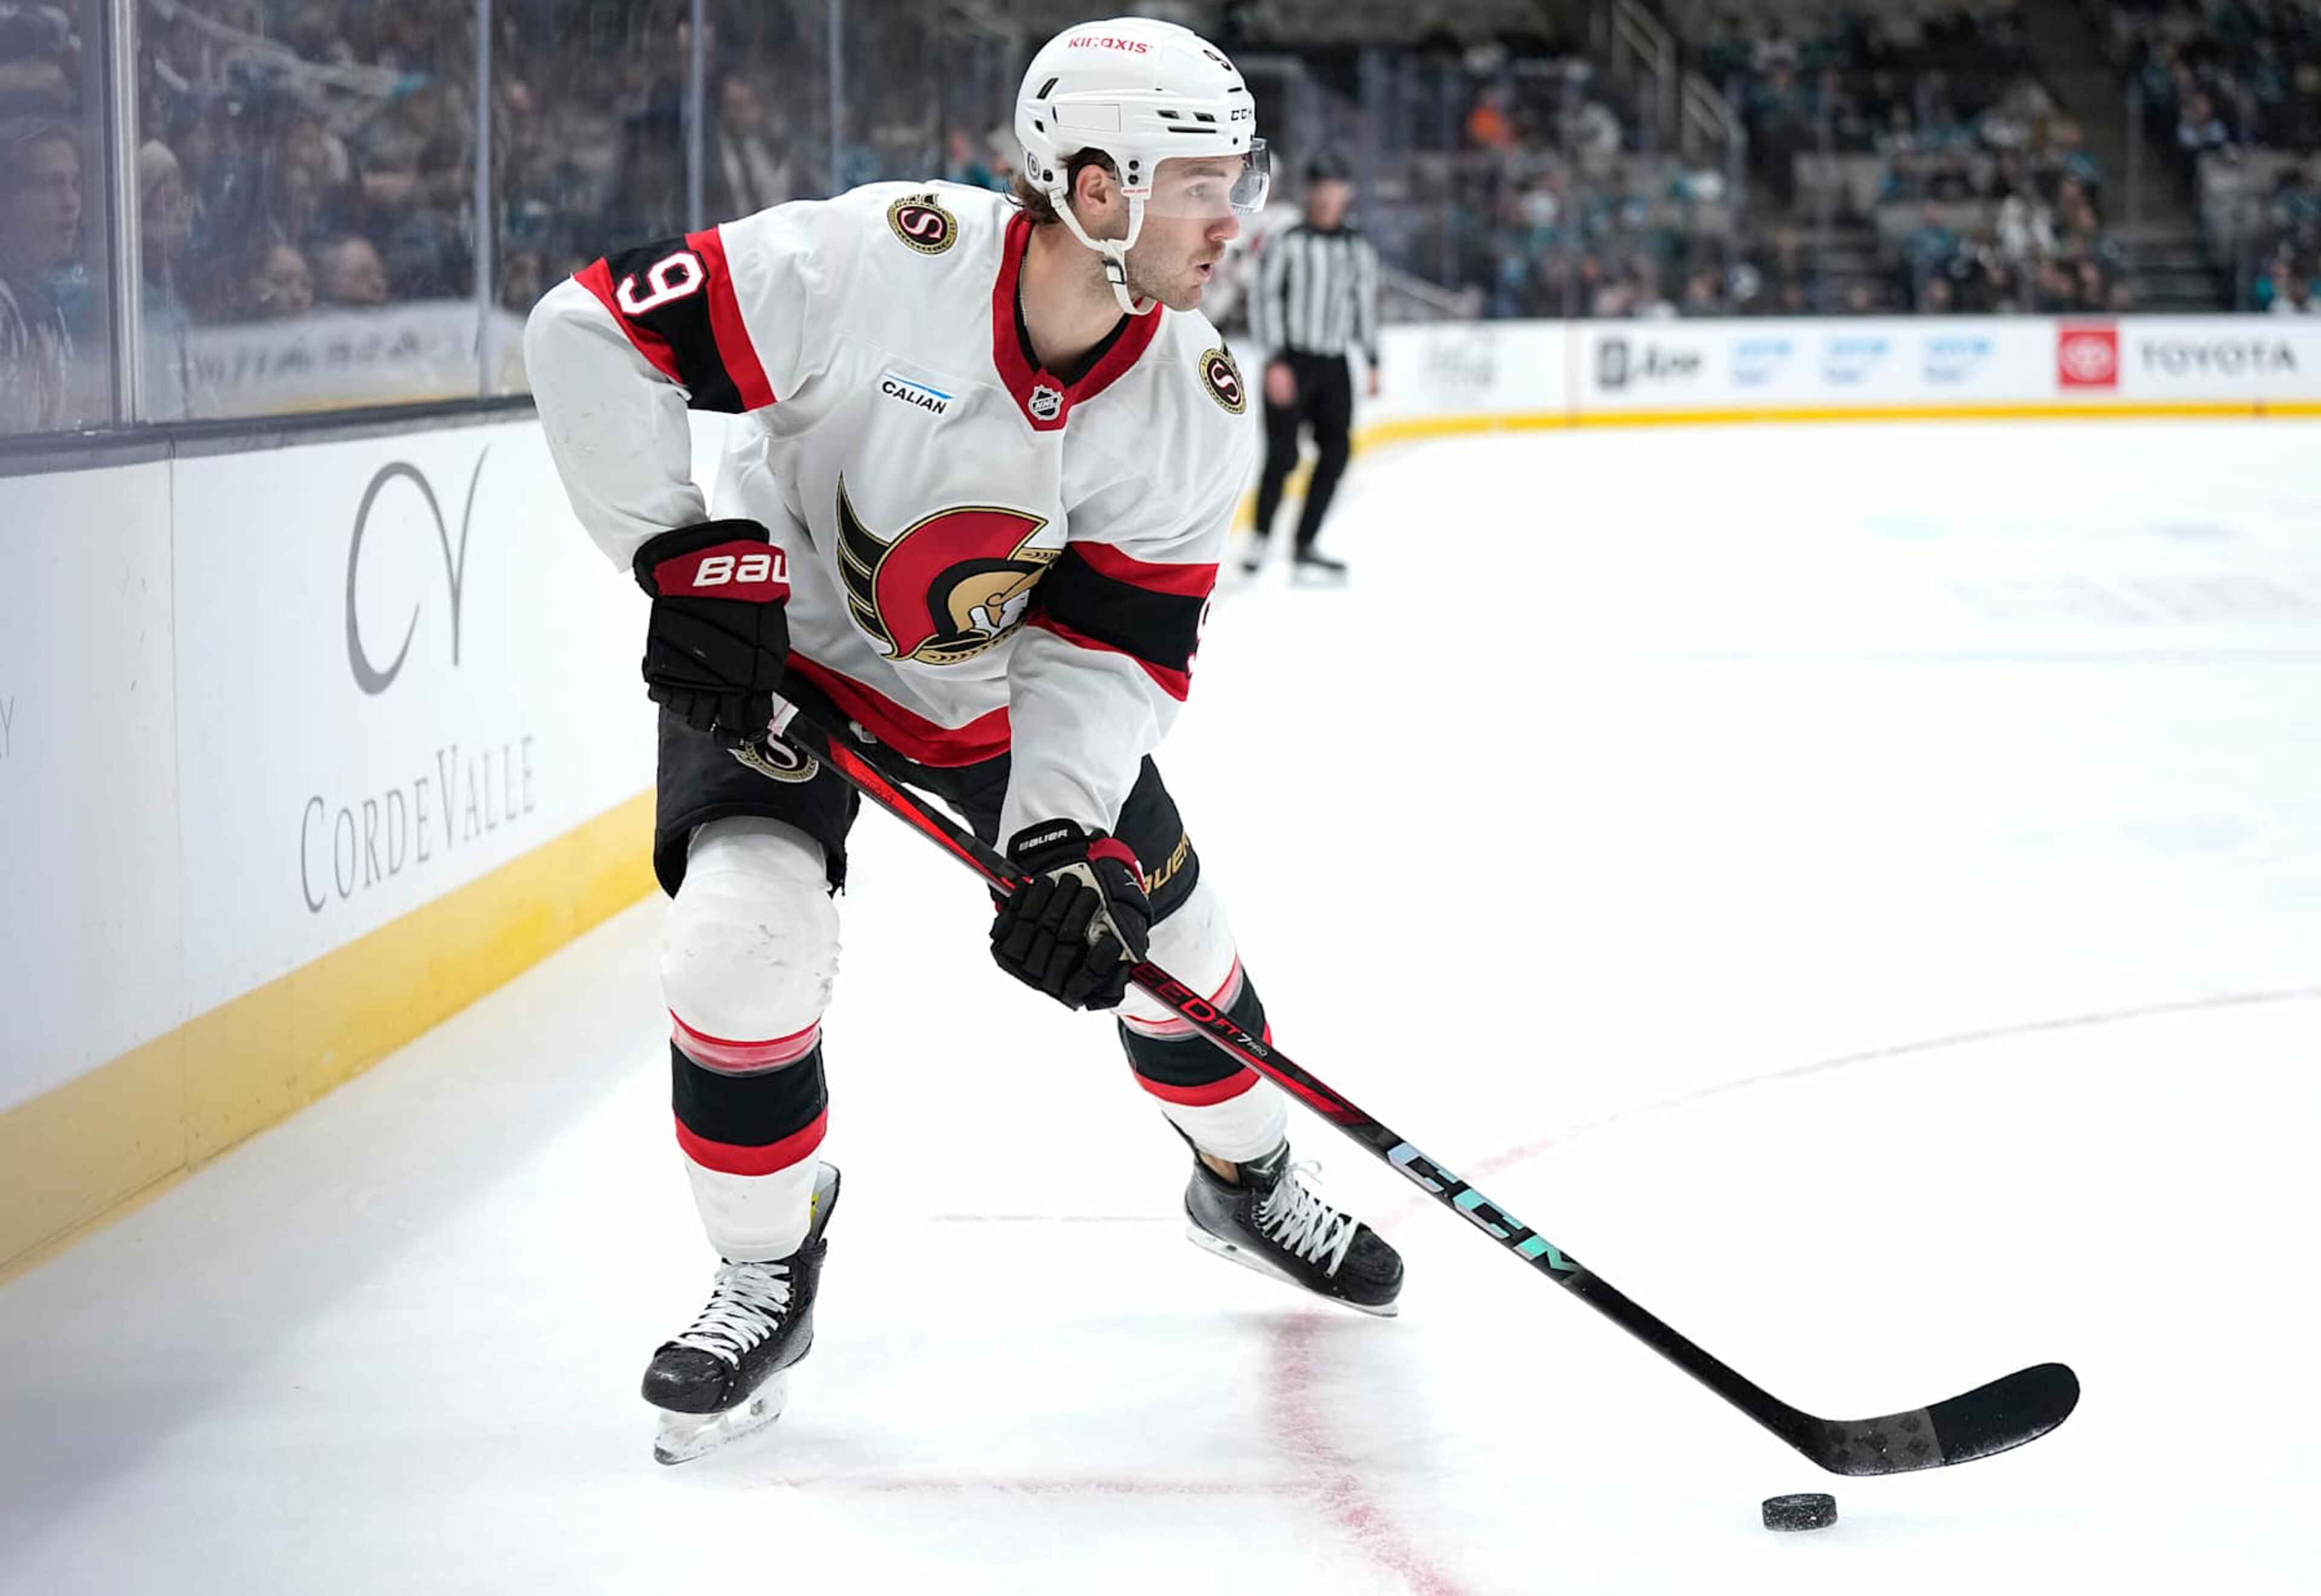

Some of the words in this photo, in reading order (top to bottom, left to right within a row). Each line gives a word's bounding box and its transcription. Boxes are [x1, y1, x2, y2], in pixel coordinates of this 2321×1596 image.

[615, 250, 709, 317] 9
[2141, 340, 2298, 376] TOYOTA
[882, 381, 947, 415] CALIAN
[1388, 1142, 1580, 1273] CCM
